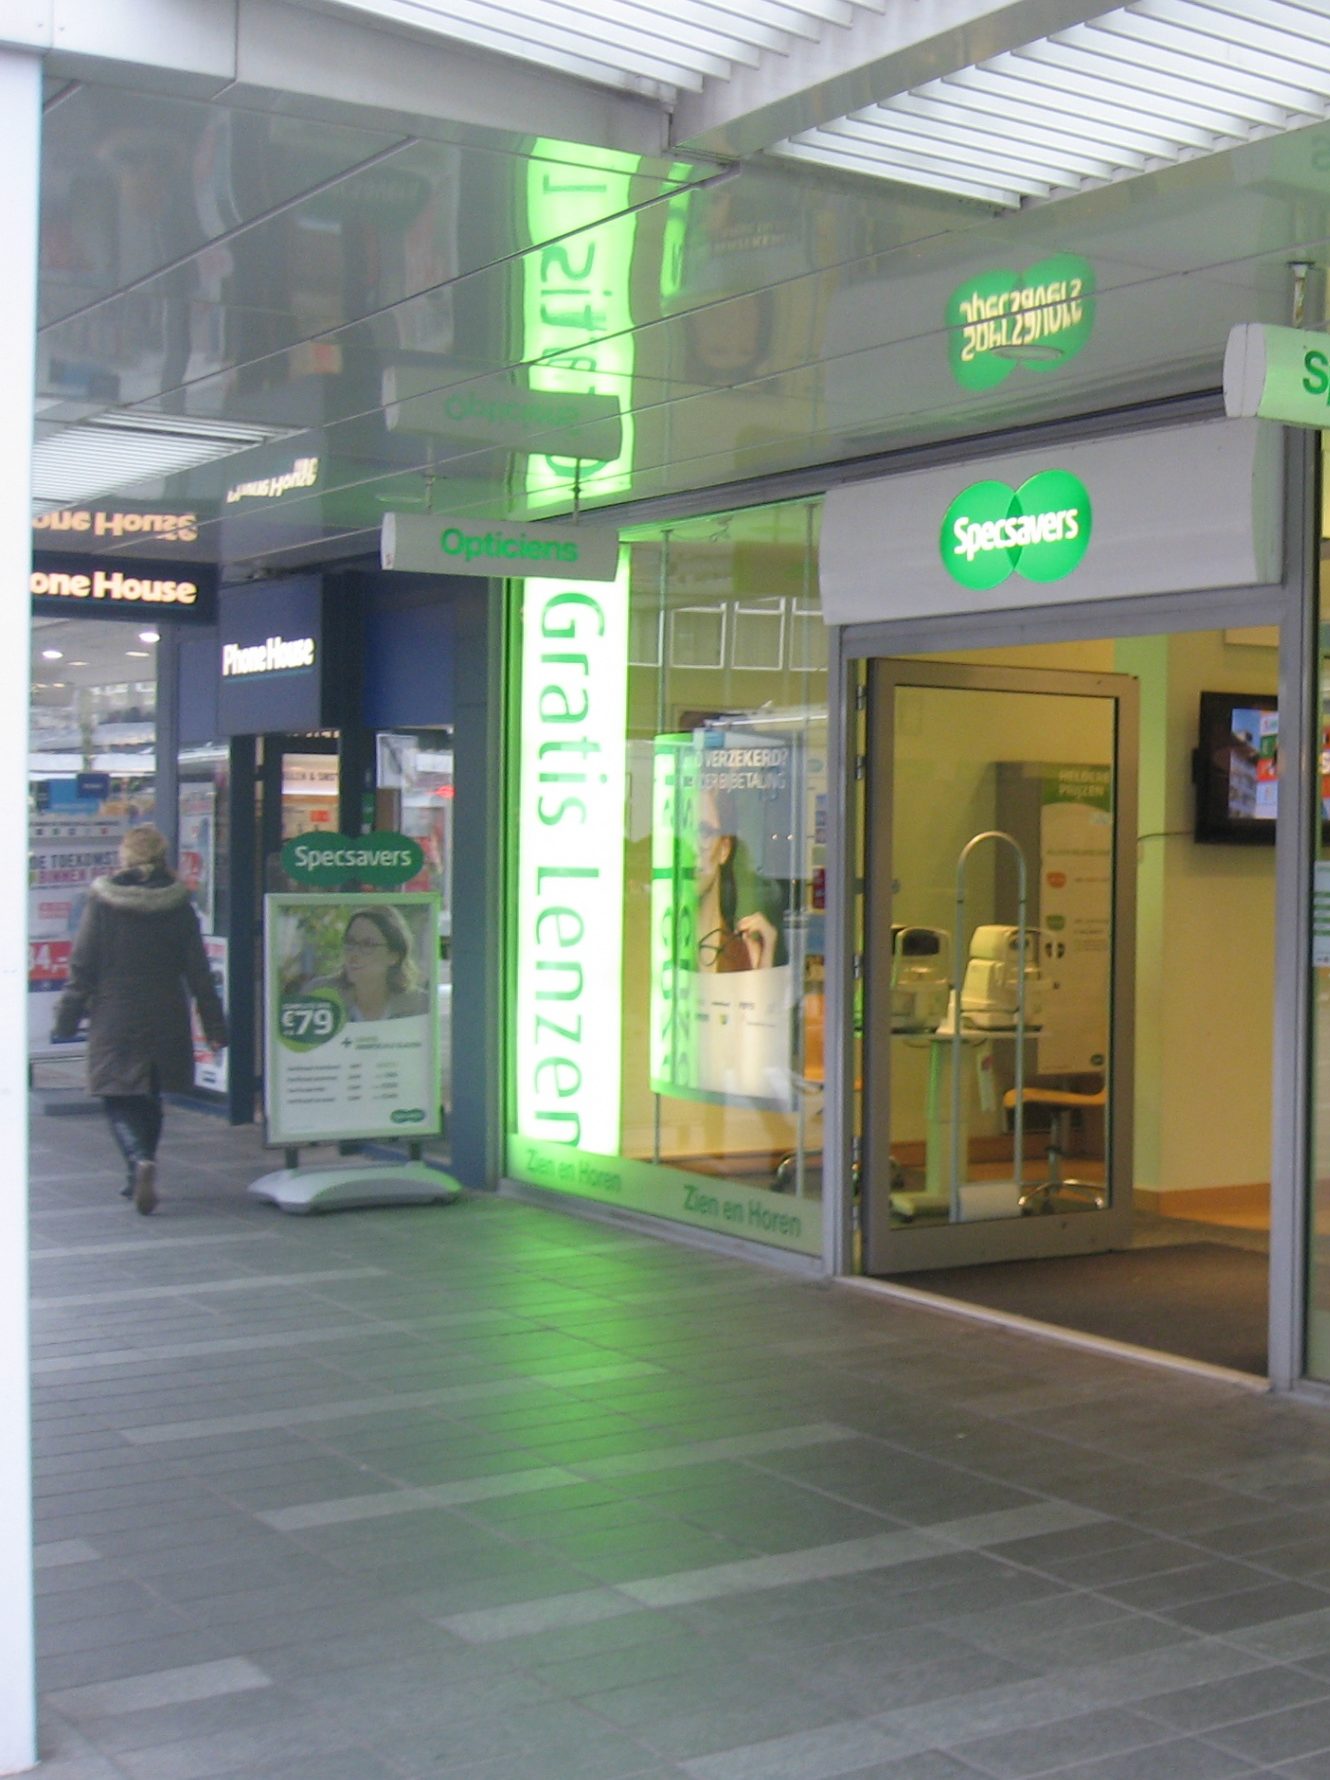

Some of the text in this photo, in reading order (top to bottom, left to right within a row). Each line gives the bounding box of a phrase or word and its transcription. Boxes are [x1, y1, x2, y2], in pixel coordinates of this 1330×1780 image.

[440, 528, 579, 562] Opticiens
[953, 507, 1079, 559] Specsavers
[30, 571, 198, 604] one House
[222, 636, 315, 676] Phone House
[537, 592, 608, 826] Gratis
[294, 846, 412, 871] Specsavers
[534, 866, 599, 1148] Lenzen
[526, 1149, 622, 1192] Zien en Horen
[683, 1184, 802, 1238] Zien en Horen
